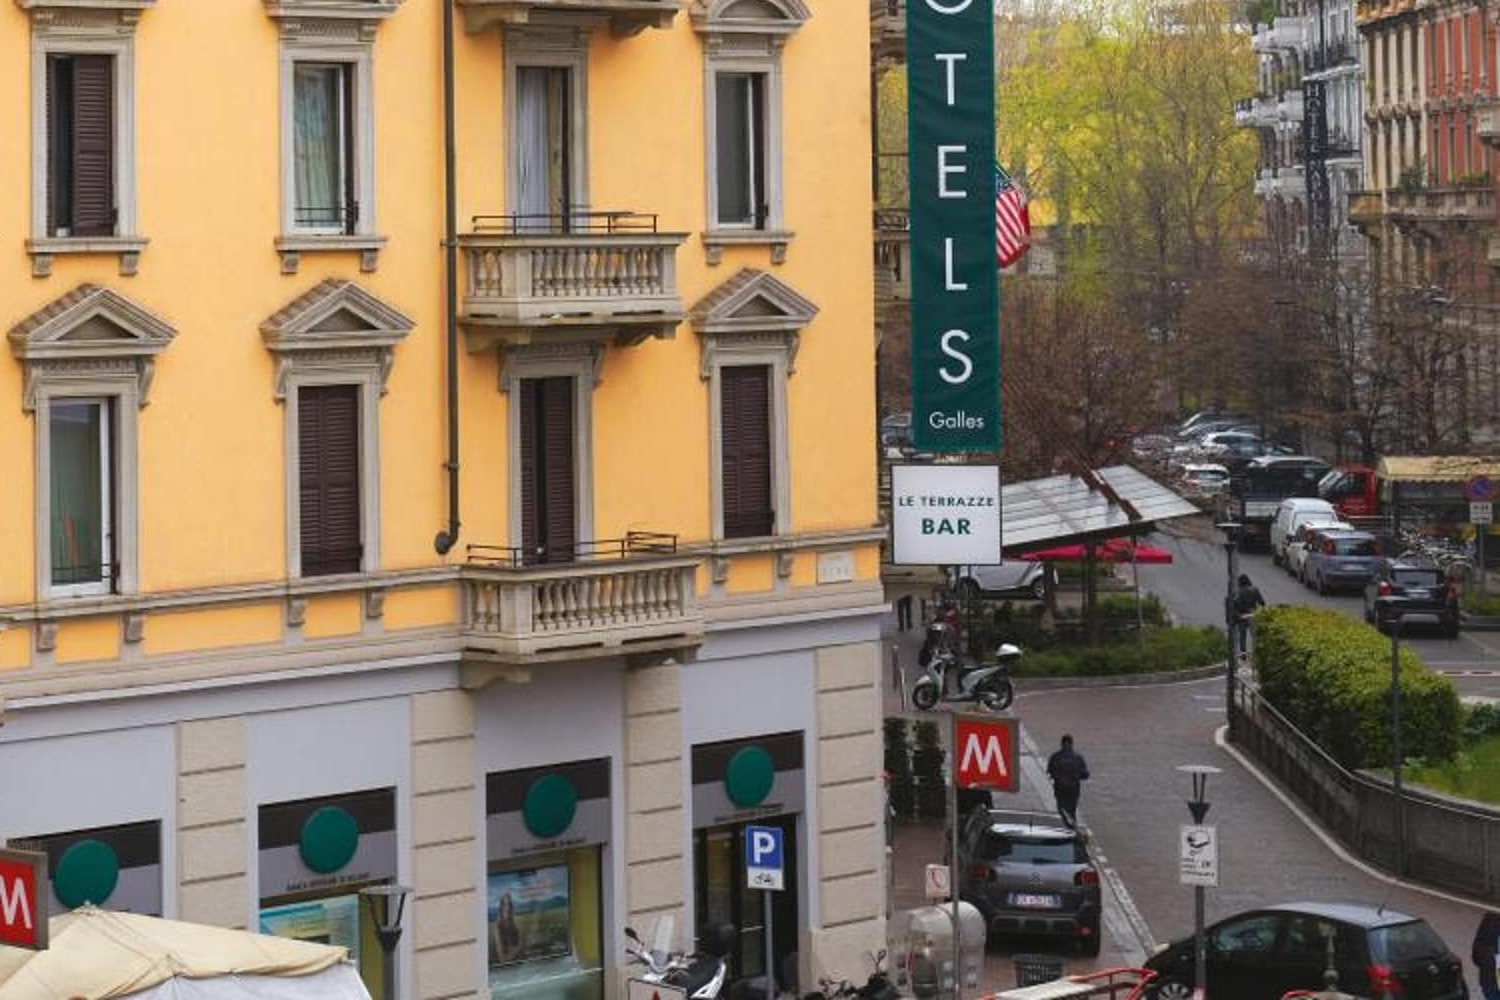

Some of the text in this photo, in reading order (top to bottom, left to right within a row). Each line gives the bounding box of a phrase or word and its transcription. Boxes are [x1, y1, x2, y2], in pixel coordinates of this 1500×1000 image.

[929, 410, 985, 429] Galles
[899, 495, 995, 507] LE TERRAZZE
[921, 517, 971, 535] BAR
[960, 733, 1007, 776] M
[753, 831, 775, 863] P
